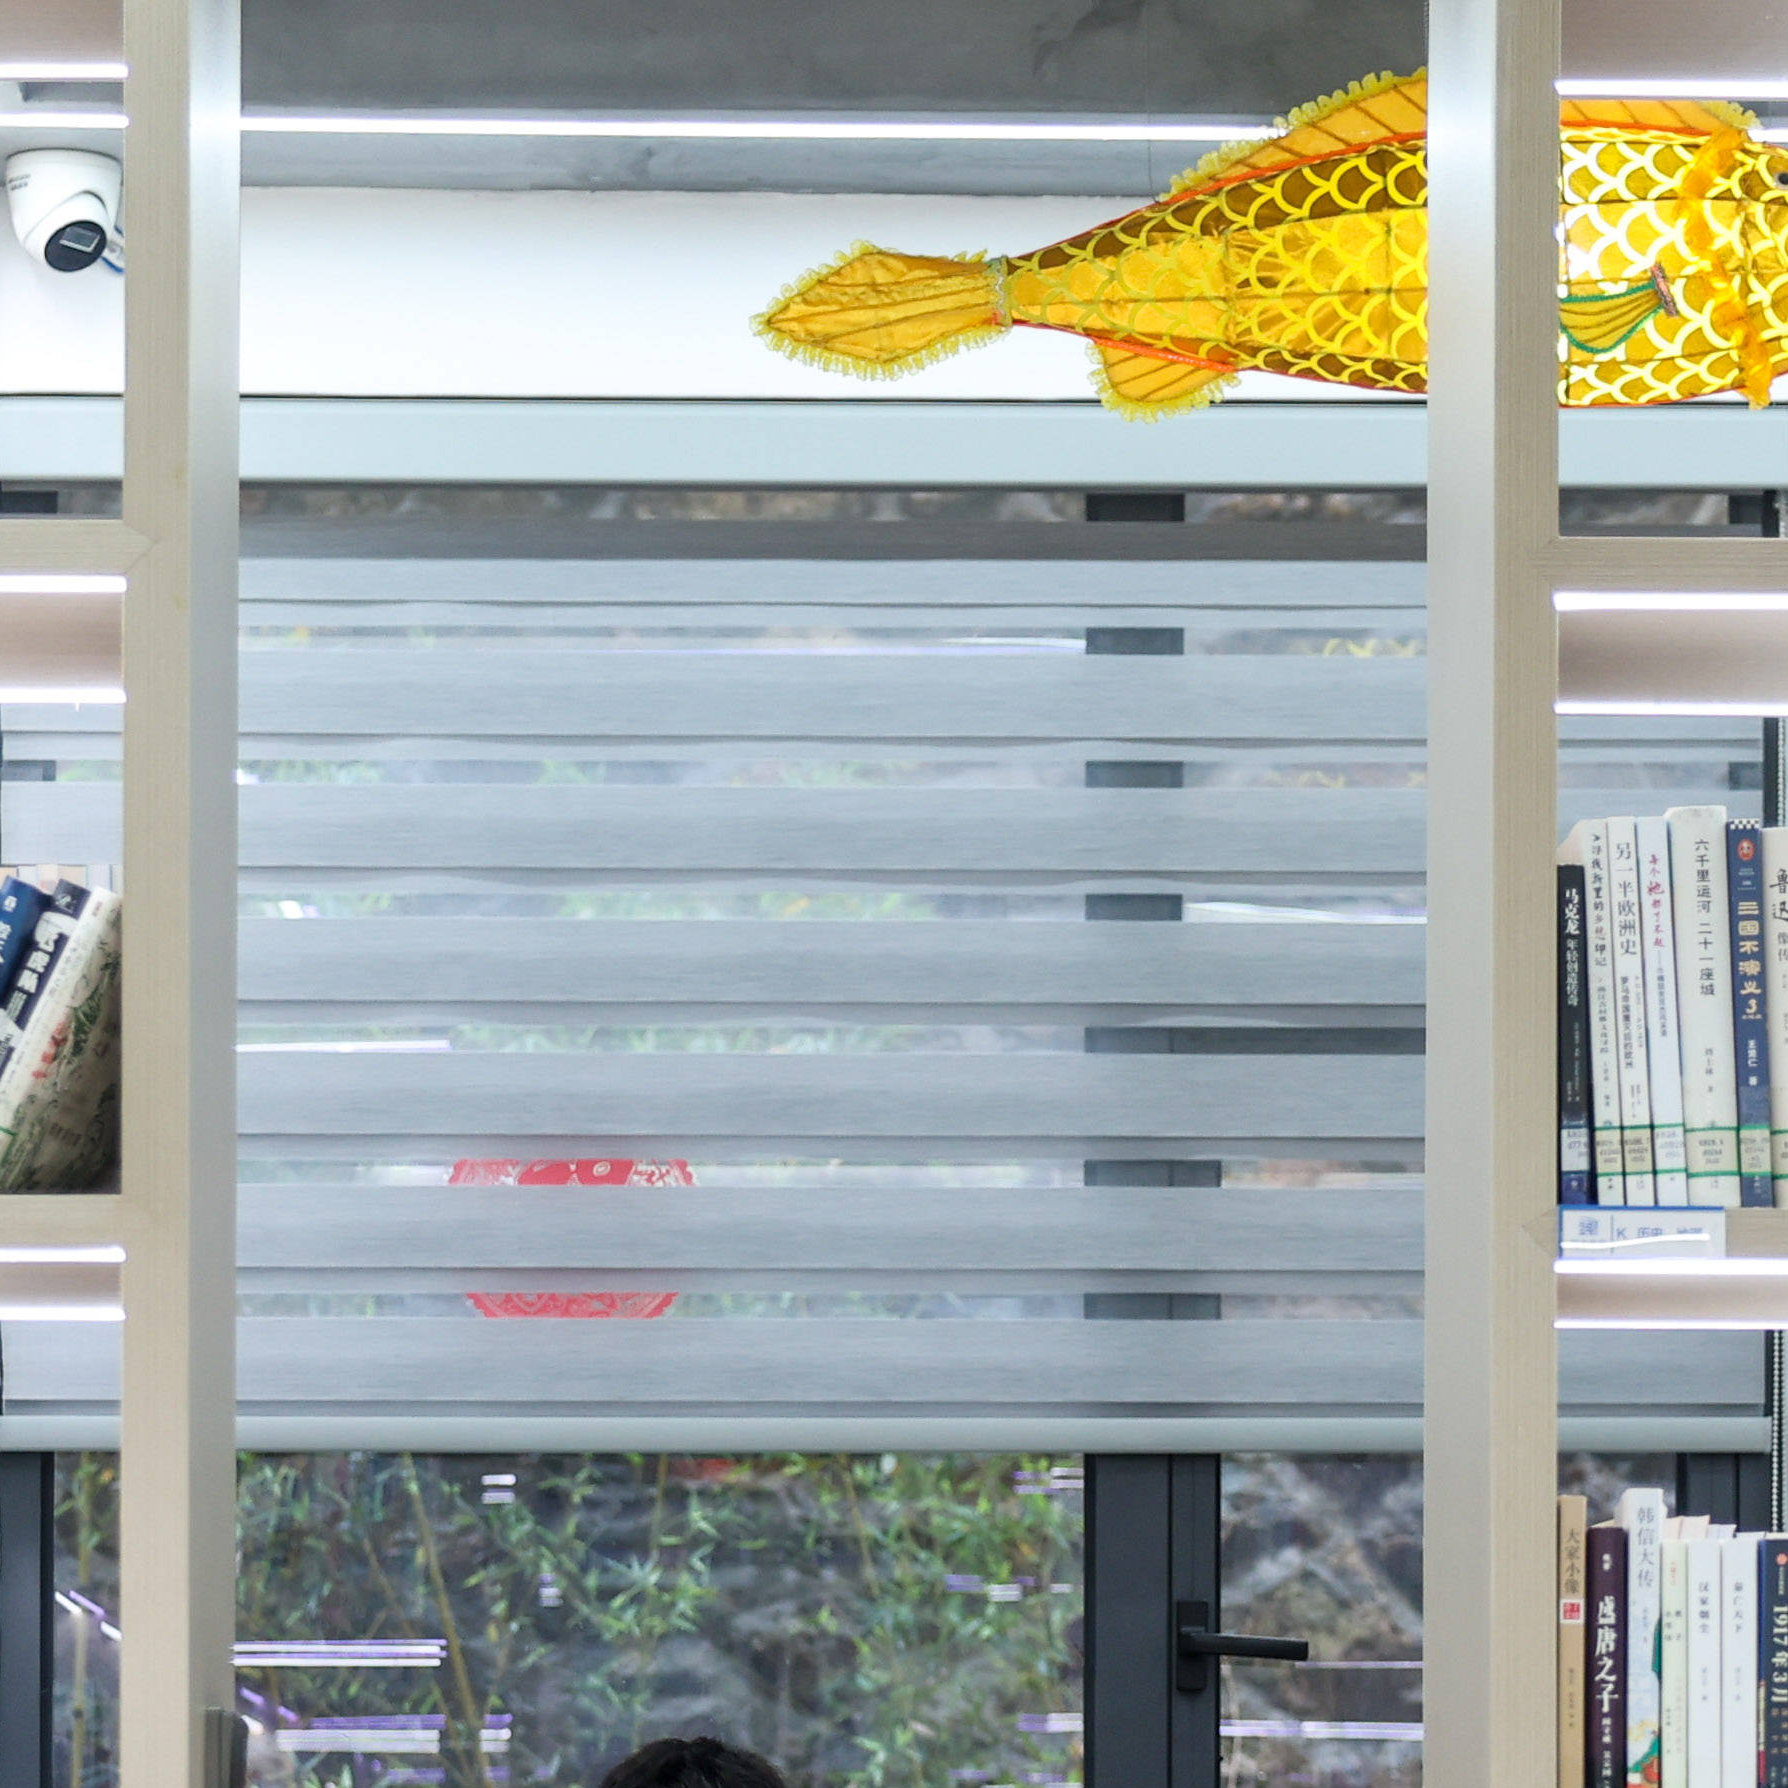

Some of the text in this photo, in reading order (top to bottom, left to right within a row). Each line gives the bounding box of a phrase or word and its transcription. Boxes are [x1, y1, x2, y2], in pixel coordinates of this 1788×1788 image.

[1615, 842, 1637, 955] 另一半欧洲史
[1694, 838, 1715, 996] 六千里运河 二十一座城
[1737, 901, 1761, 995] 三国不演义
[1637, 1507, 1655, 1588] 韩信大传
[1594, 1594, 1619, 1713] 盛唐之子
